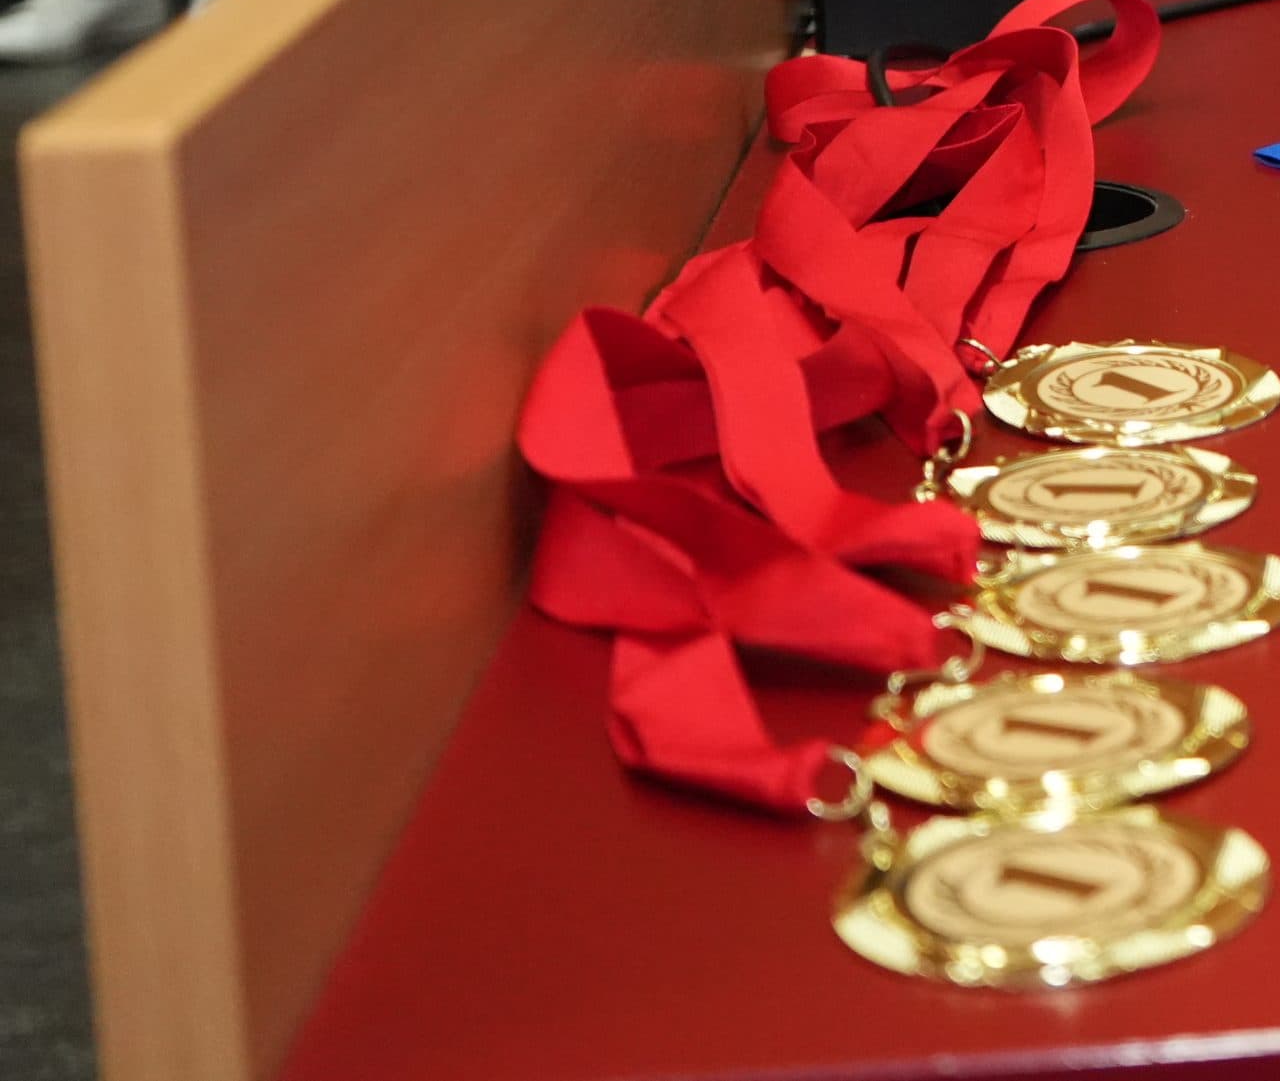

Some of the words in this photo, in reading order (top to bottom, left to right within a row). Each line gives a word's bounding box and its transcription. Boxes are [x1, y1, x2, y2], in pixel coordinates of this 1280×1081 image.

[1093, 372, 1185, 404] 1
[1046, 479, 1146, 501] 1
[1084, 582, 1182, 608] 1
[1004, 719, 1101, 741] 1
[1001, 866, 1101, 896] 1
